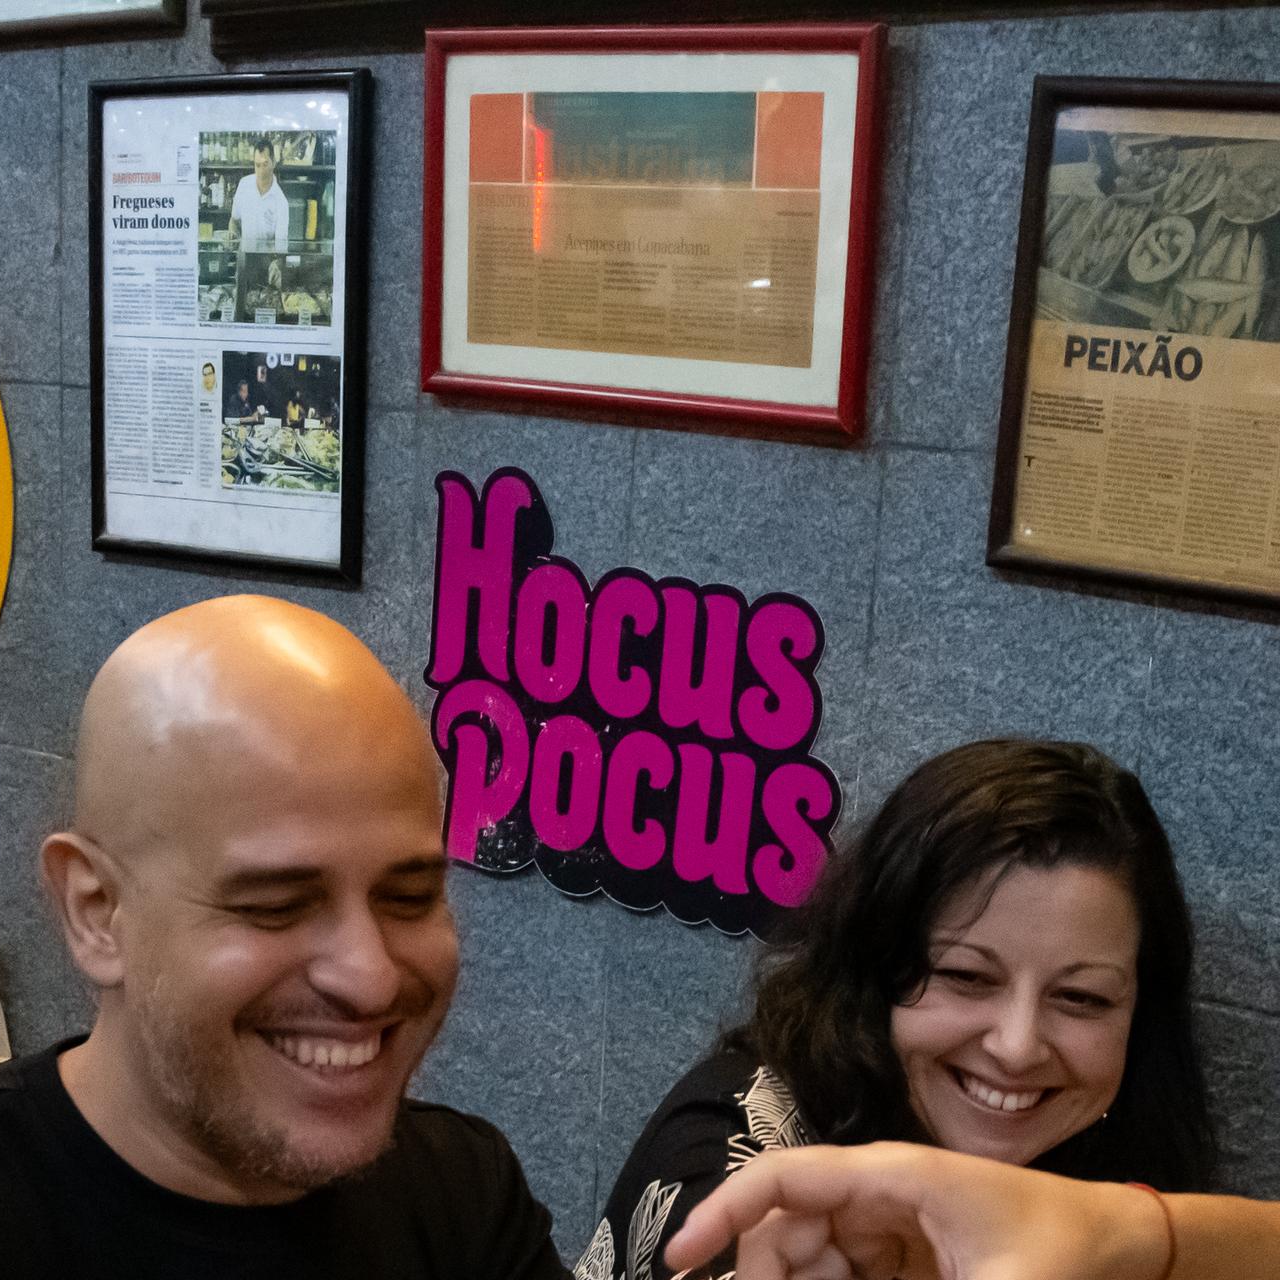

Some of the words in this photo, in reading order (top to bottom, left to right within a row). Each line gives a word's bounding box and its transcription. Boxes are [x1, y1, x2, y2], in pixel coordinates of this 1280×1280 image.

[113, 195, 175, 212] Fregueses
[112, 214, 149, 229] viram
[151, 214, 190, 229] donos
[1064, 334, 1203, 381] PEIXÃO
